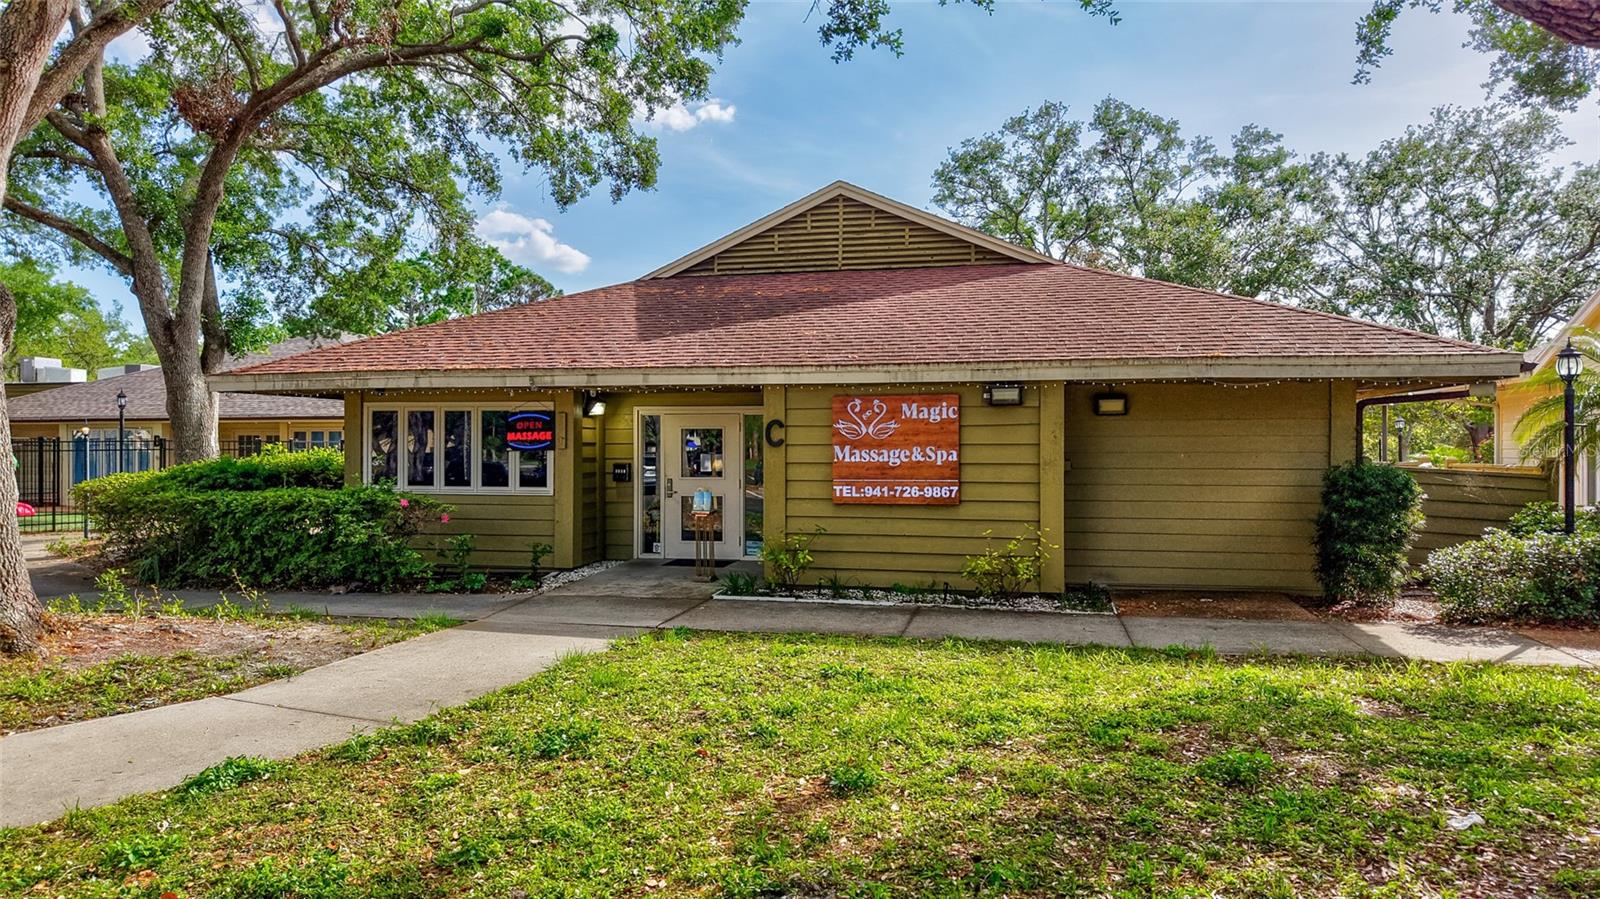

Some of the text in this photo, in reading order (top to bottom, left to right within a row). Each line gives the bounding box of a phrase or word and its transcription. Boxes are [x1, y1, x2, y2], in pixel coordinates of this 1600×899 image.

[901, 401, 958, 423] Magic
[516, 421, 543, 430] OPEN
[765, 419, 785, 447] C
[507, 431, 552, 440] MASSAGE
[833, 445, 958, 467] Massage&Spa
[832, 485, 959, 498] TEL:941-726-9867
